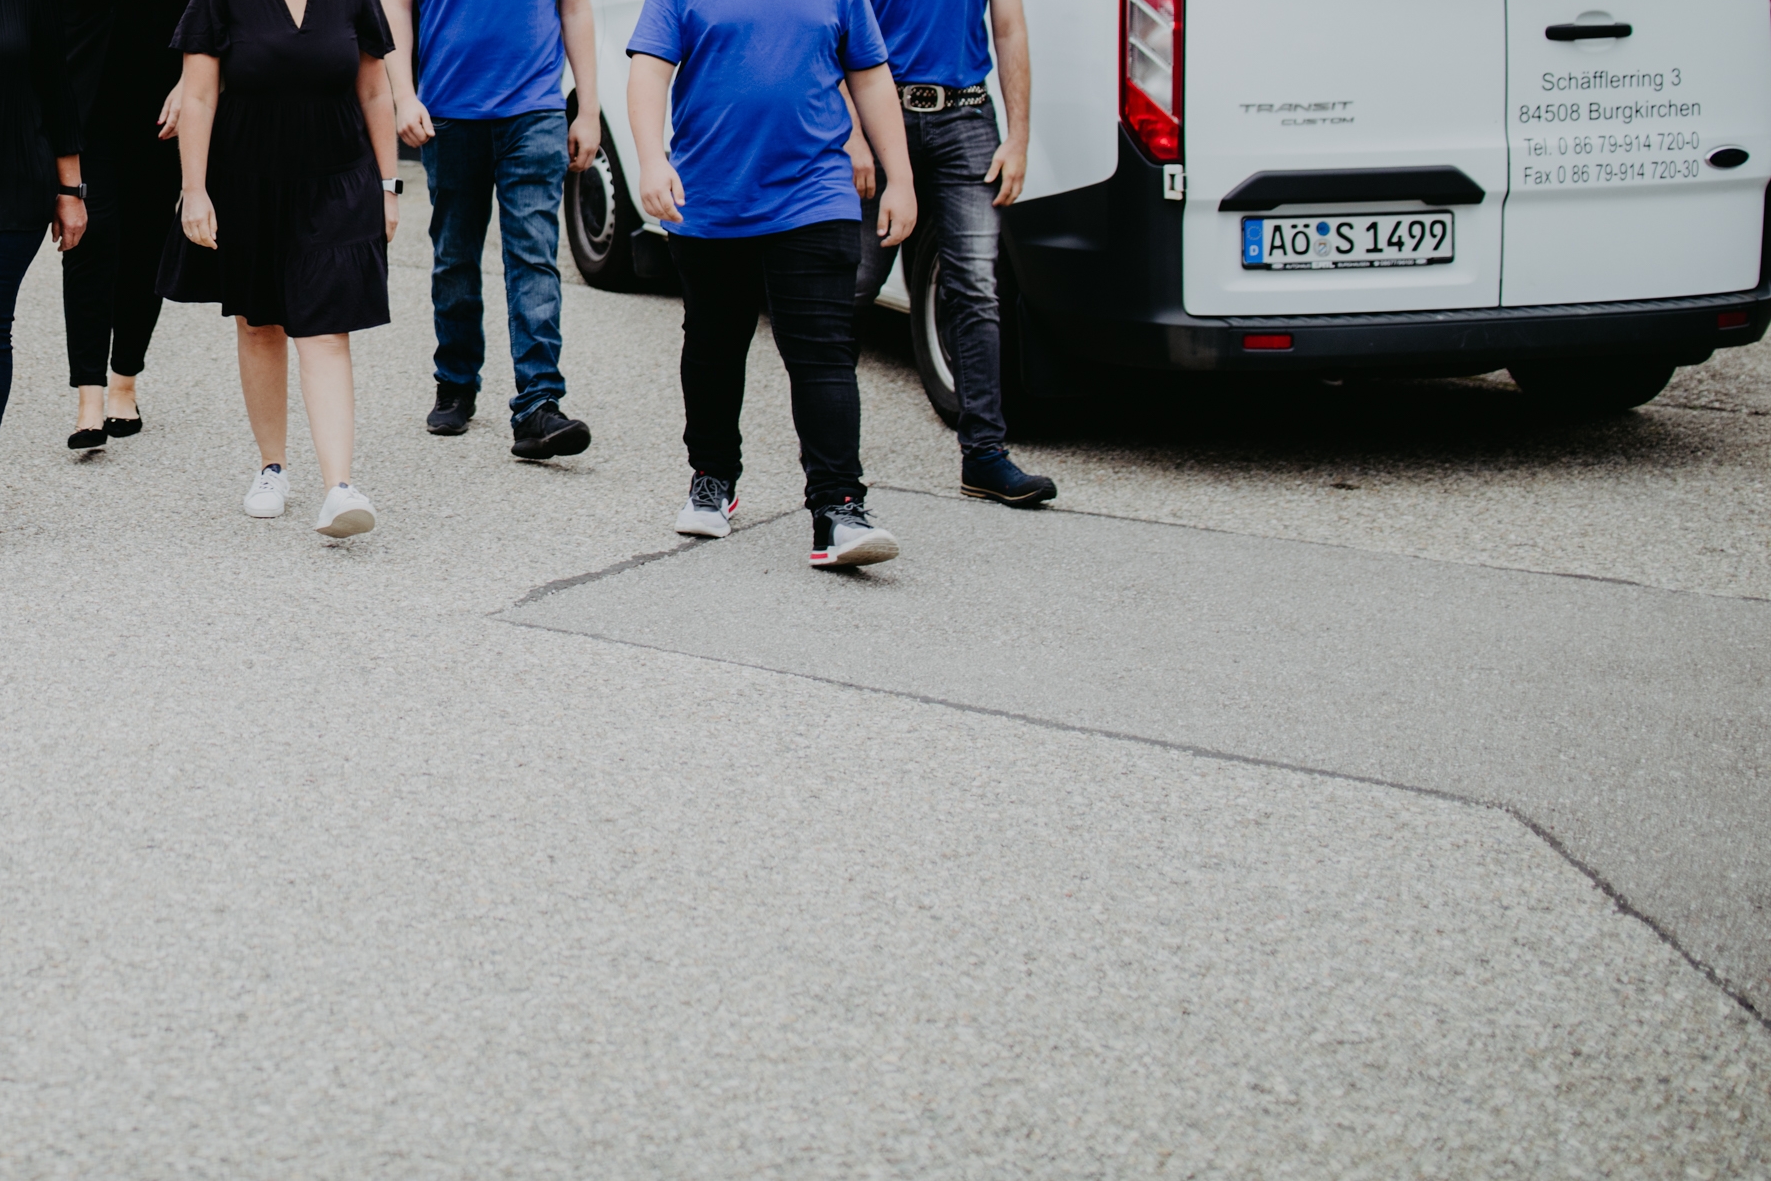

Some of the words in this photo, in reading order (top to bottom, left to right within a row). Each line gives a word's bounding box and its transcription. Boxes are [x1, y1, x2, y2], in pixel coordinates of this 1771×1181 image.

[1541, 70, 1665, 92] Schäfflerring
[1671, 68, 1682, 87] 3
[1239, 101, 1354, 113] TRANSIT
[1519, 103, 1581, 123] 84508
[1588, 99, 1702, 124] Burgkirchen
[1281, 117, 1355, 126] CUSTOM
[1524, 137, 1553, 156] Tel.
[1558, 136, 1568, 155] 0
[1573, 135, 1593, 155] 86
[1597, 133, 1652, 153] 79-914
[1657, 131, 1700, 151] 720-0
[1524, 166, 1552, 185] Fax
[1557, 165, 1566, 183] 0
[1572, 164, 1590, 183] 86
[1595, 162, 1645, 181] 79-914
[1650, 159, 1700, 179] 720-30
[1269, 223, 1311, 256] AÖ
[1335, 222, 1355, 254] S
[1365, 219, 1448, 253] 1499
